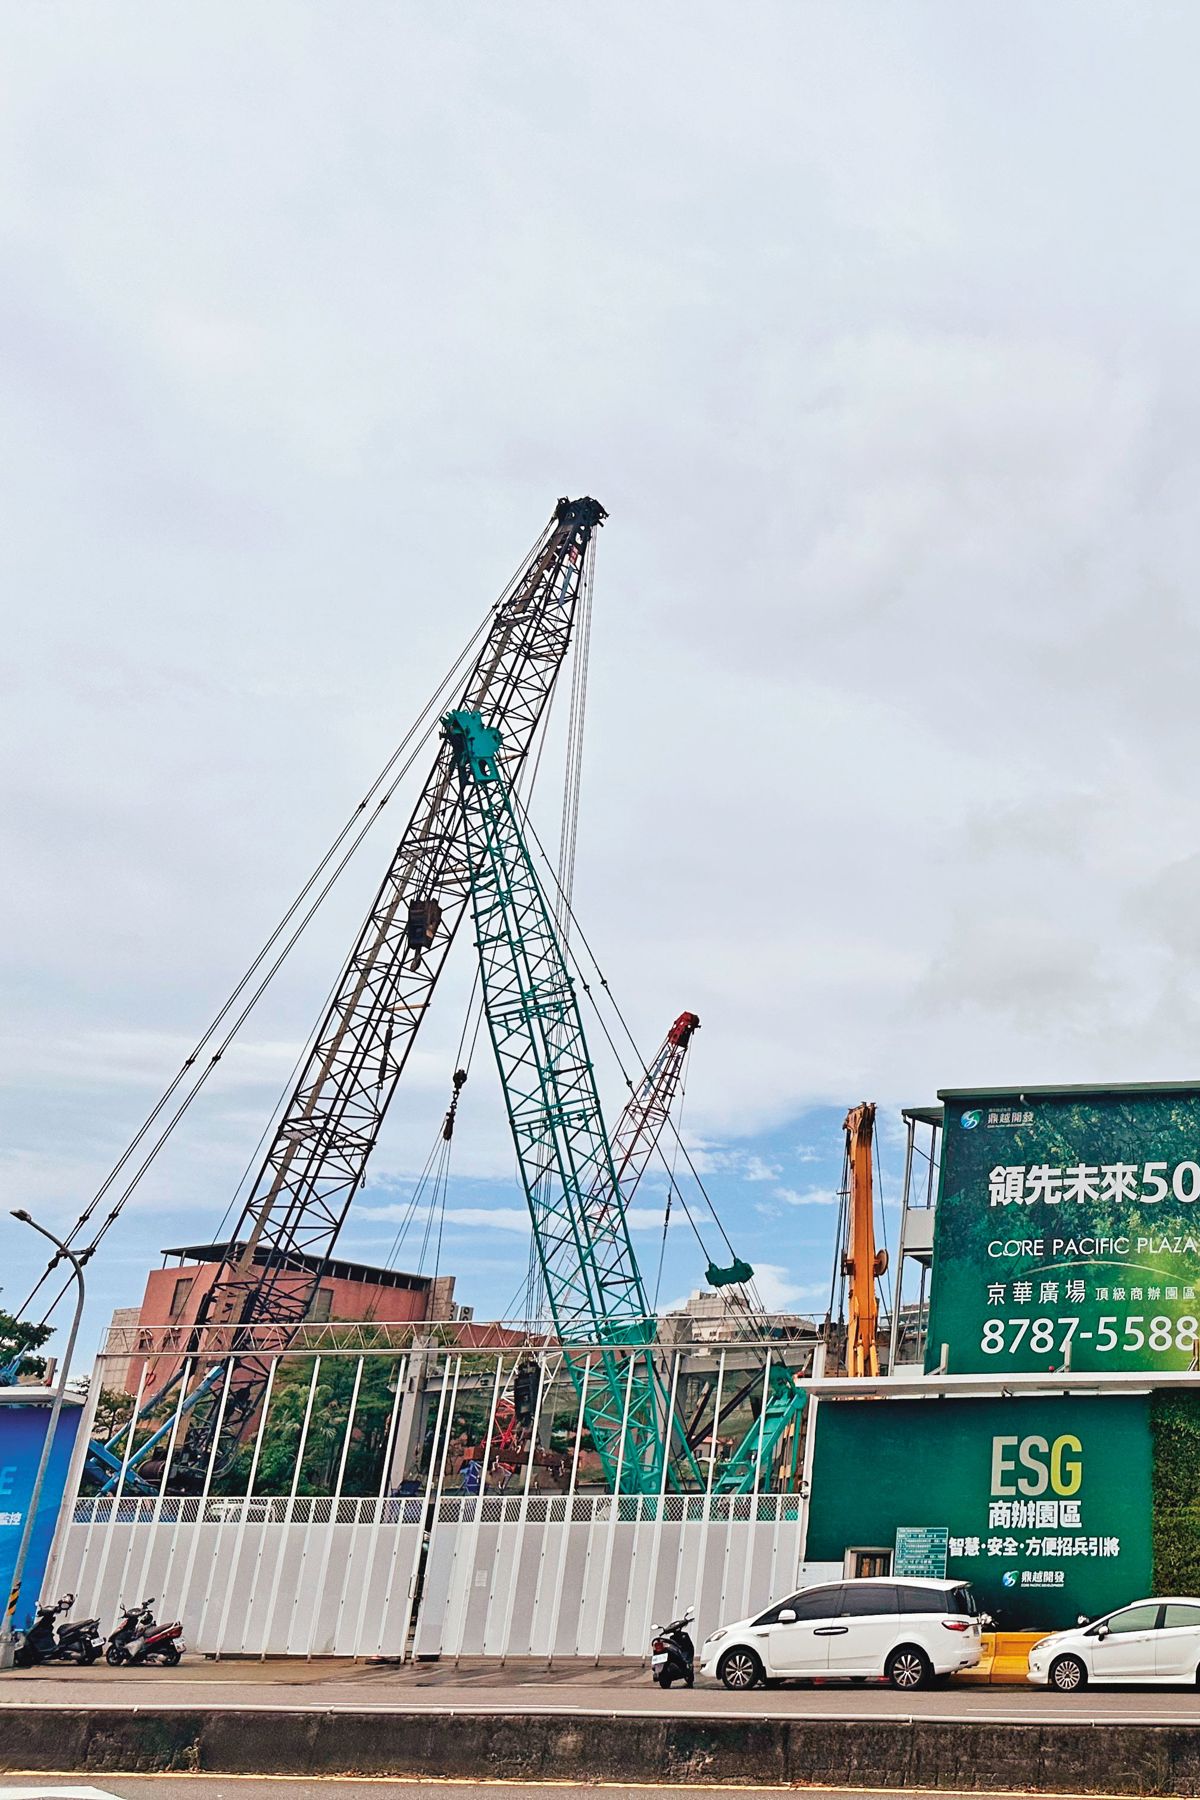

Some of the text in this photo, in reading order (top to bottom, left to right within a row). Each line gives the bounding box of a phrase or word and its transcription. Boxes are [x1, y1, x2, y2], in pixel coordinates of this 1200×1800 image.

[987, 1236, 1197, 1257] CORE PACIFIC PLAZA
[987, 1279, 1197, 1306] 京華廣場 頂級商辦園區
[980, 1315, 1199, 1355] 8787-5588
[990, 1434, 1082, 1496] ESG
[988, 1500, 1082, 1529] 商辦園區
